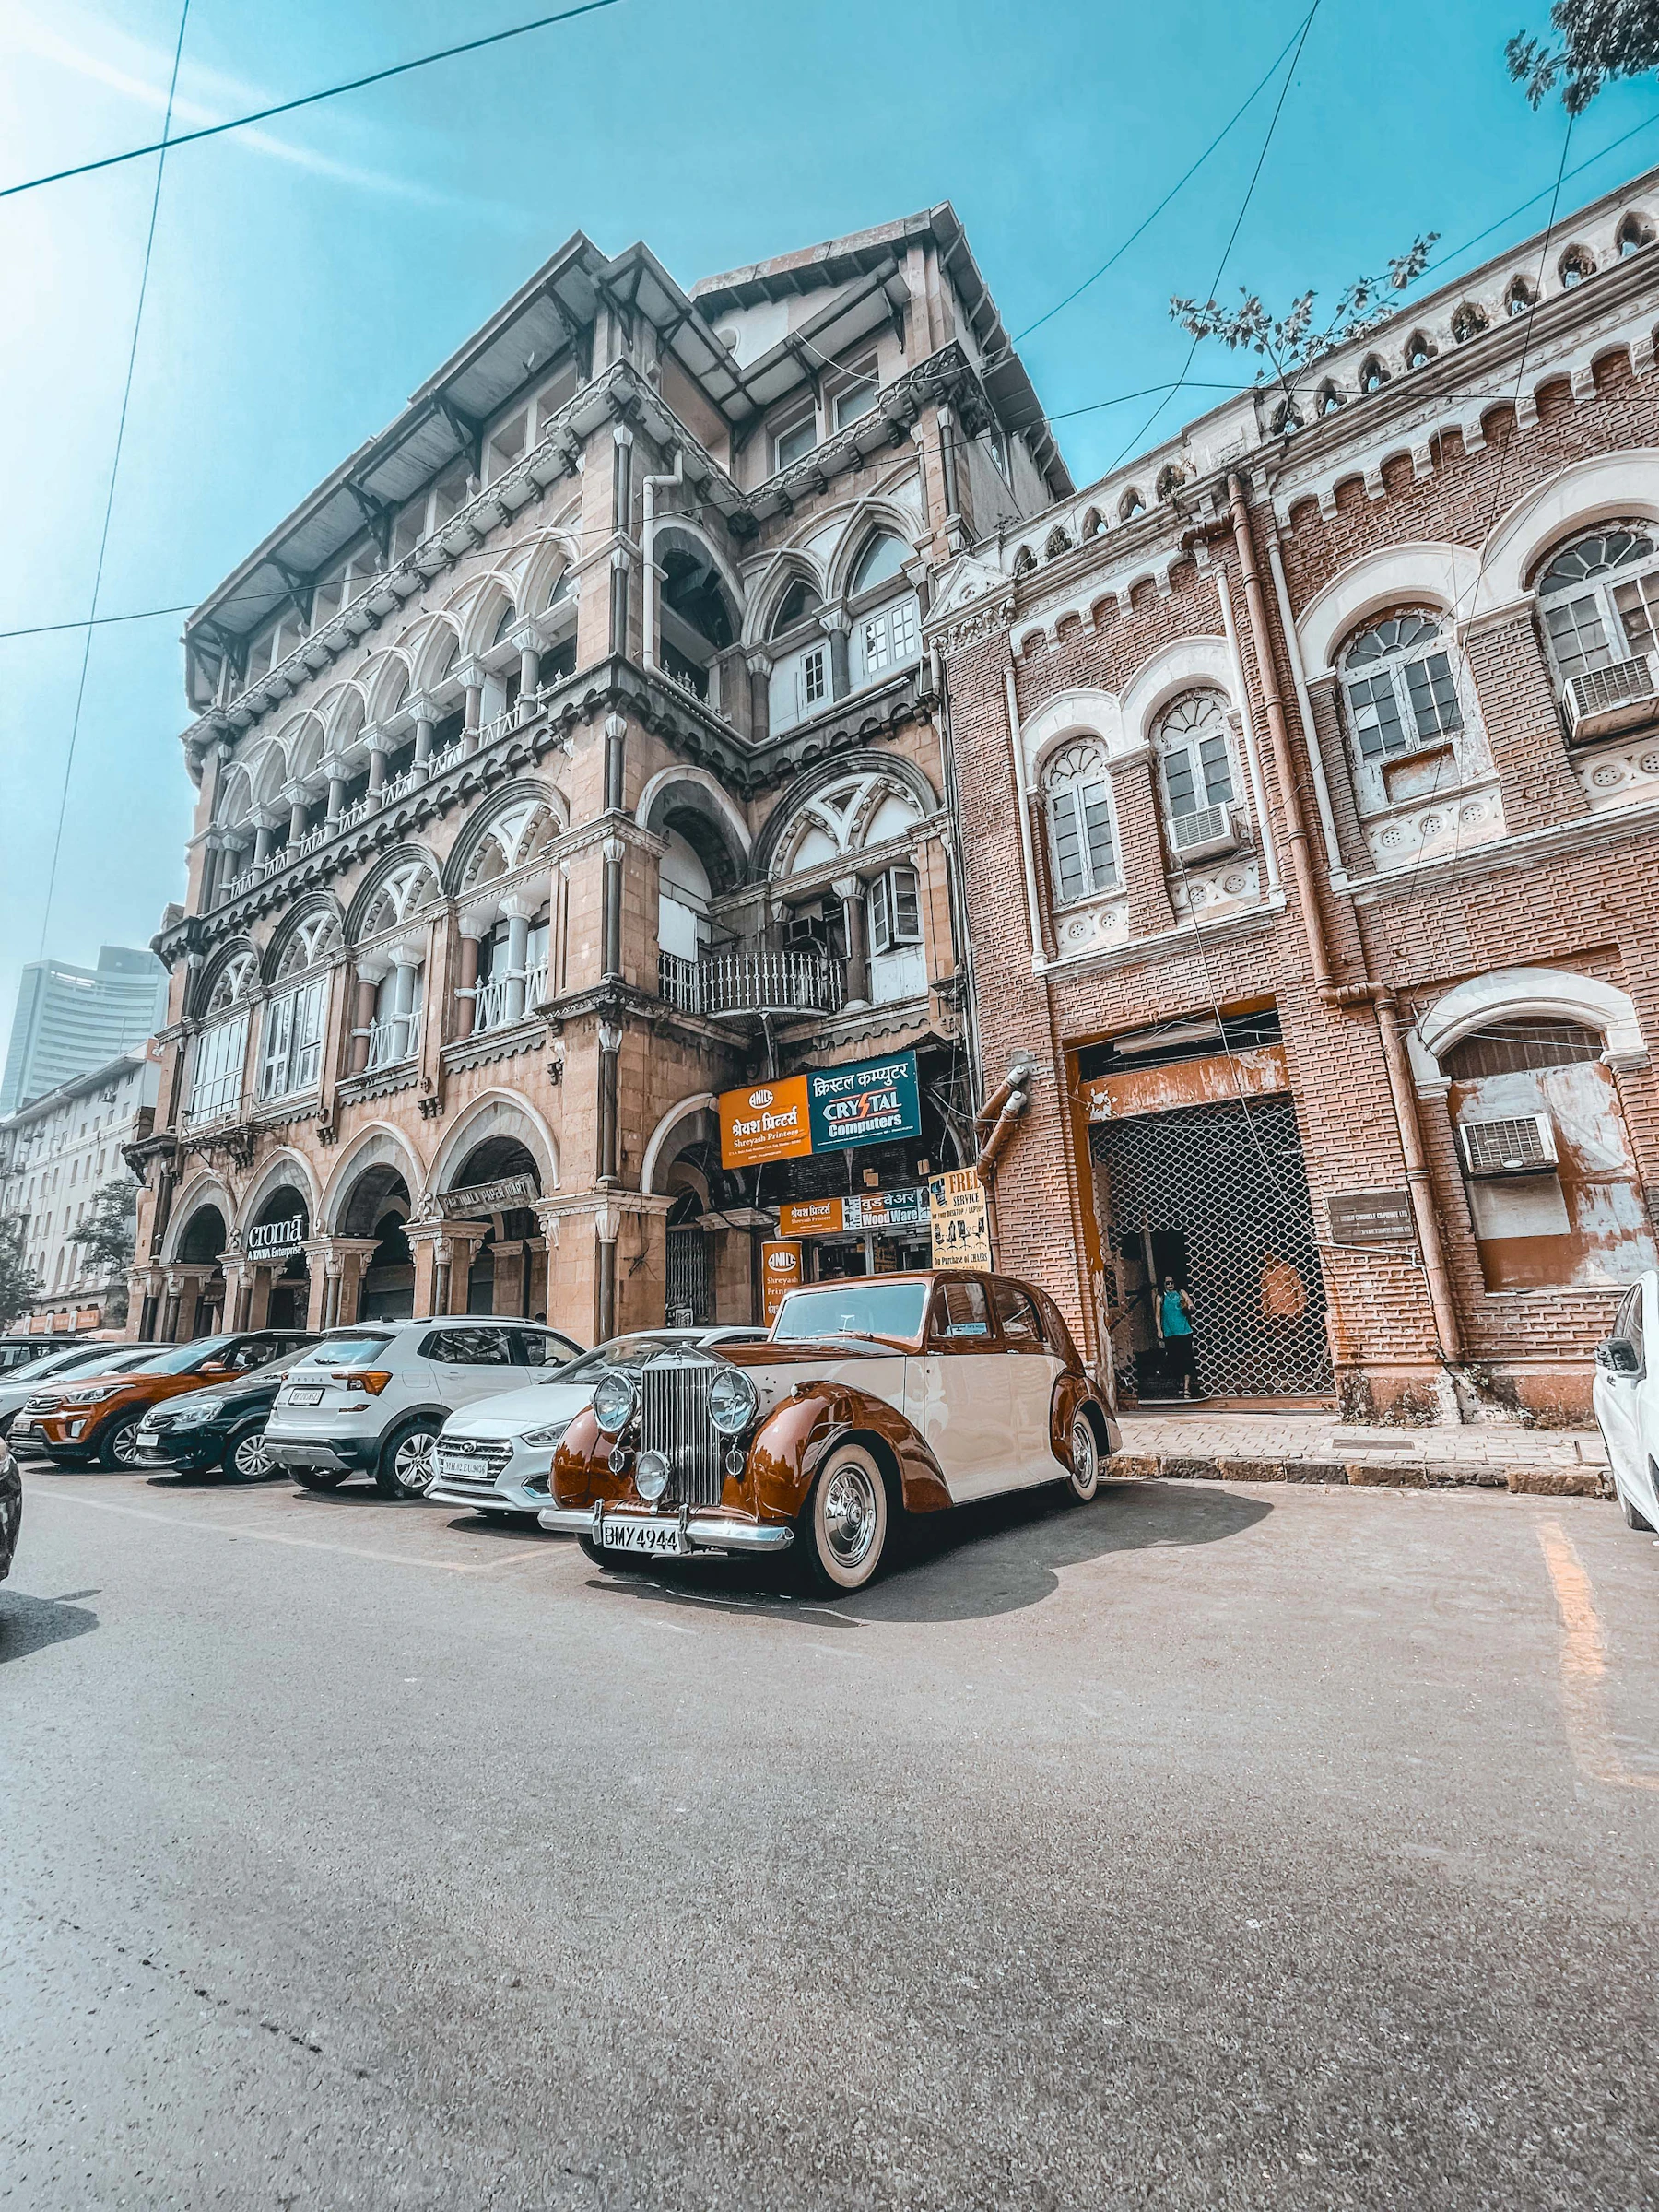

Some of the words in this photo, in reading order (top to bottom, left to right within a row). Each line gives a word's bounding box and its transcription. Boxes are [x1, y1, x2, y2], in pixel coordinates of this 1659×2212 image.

[823, 1092, 902, 1121] CRYSTAL
[829, 1114, 902, 1138] Computers
[734, 1135, 766, 1148] Shreyash
[767, 1129, 799, 1141] Printers
[481, 1186, 506, 1203] PAPER
[953, 1193, 979, 1206] SERVICE
[863, 1211, 890, 1226] Wood
[890, 1208, 919, 1222] Ware
[947, 1208, 964, 1217] DESKTOP
[247, 1251, 253, 1261] A
[253, 1248, 270, 1261] TATA
[271, 1243, 302, 1259] Enterprise
[935, 1257, 941, 1265] On
[941, 1256, 963, 1265] Purchase
[964, 1254, 970, 1263] of
[970, 1253, 988, 1262] CHAIRS
[767, 1276, 798, 1285] Shreyash
